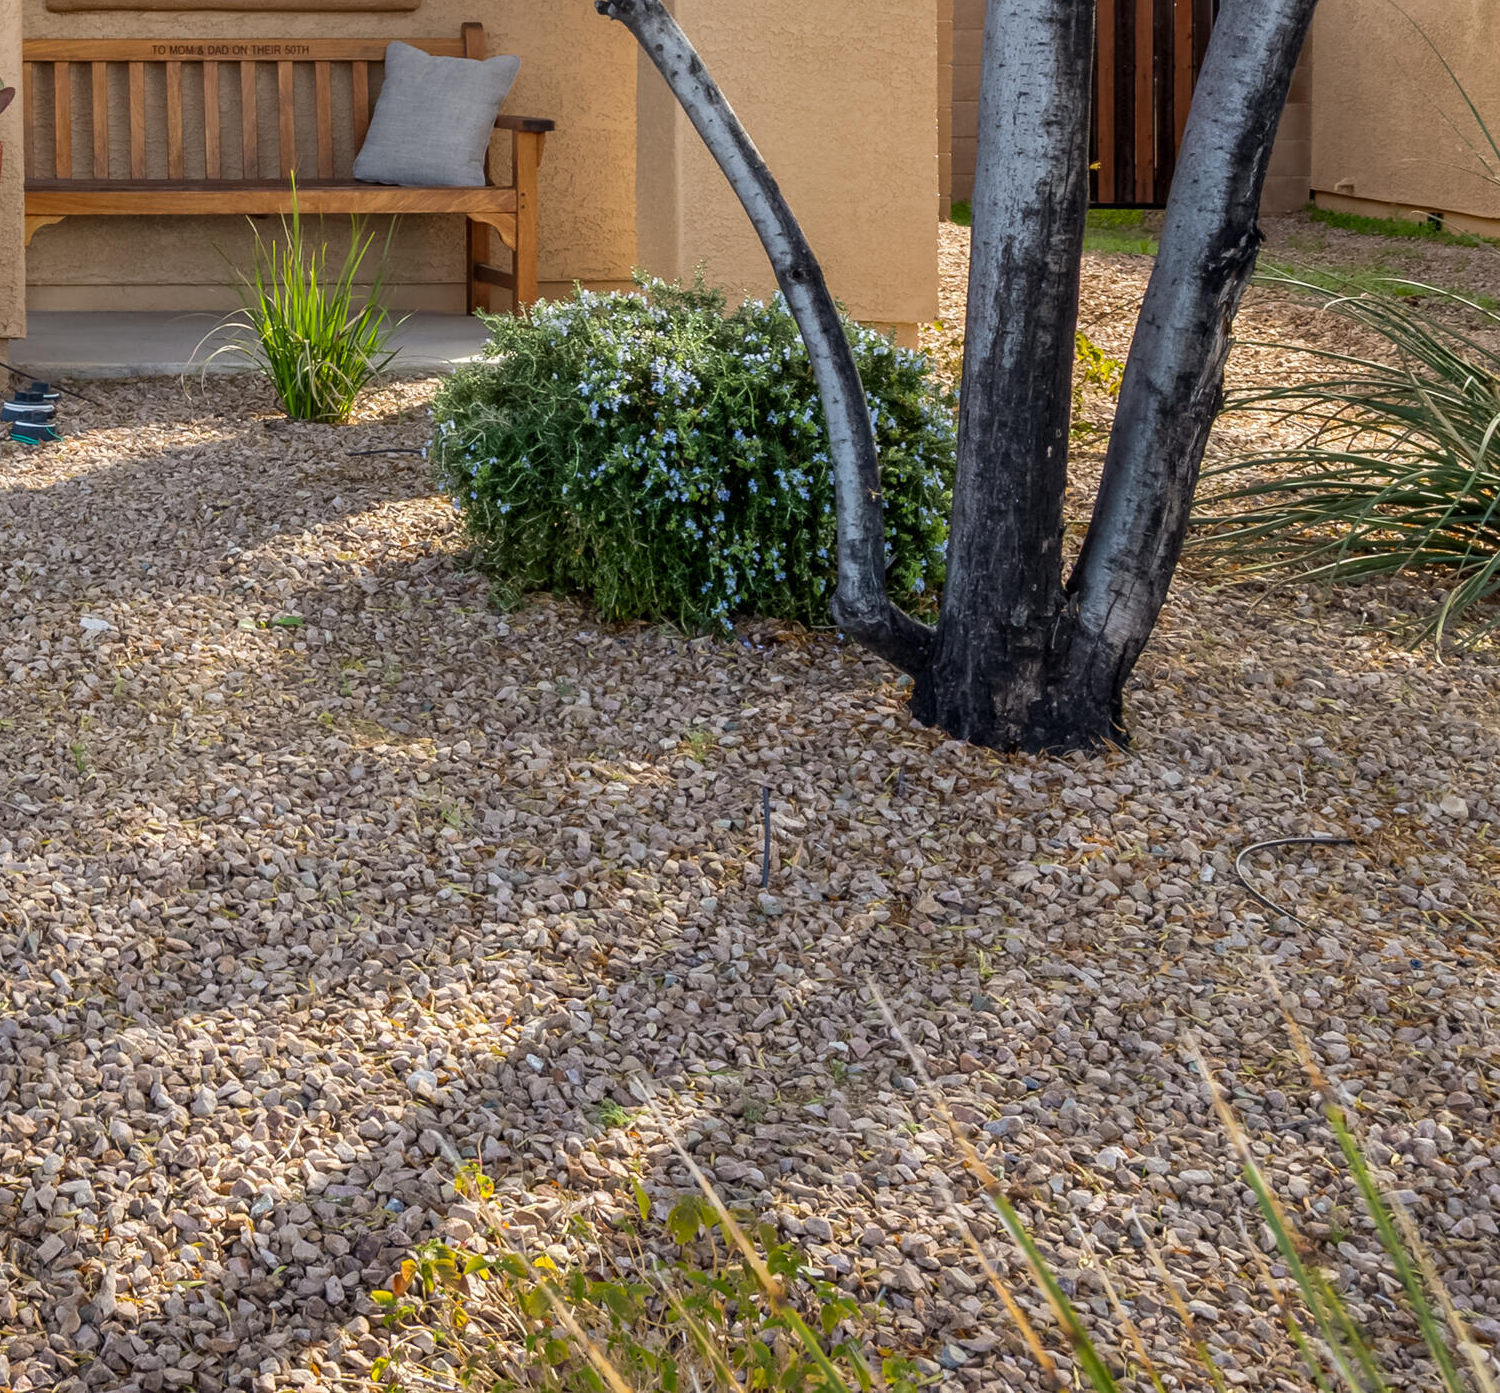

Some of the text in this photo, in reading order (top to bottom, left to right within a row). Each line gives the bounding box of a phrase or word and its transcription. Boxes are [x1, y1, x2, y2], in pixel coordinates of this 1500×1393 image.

[152, 45, 310, 55] TO MOM & DAD ON THEIR 50TH
